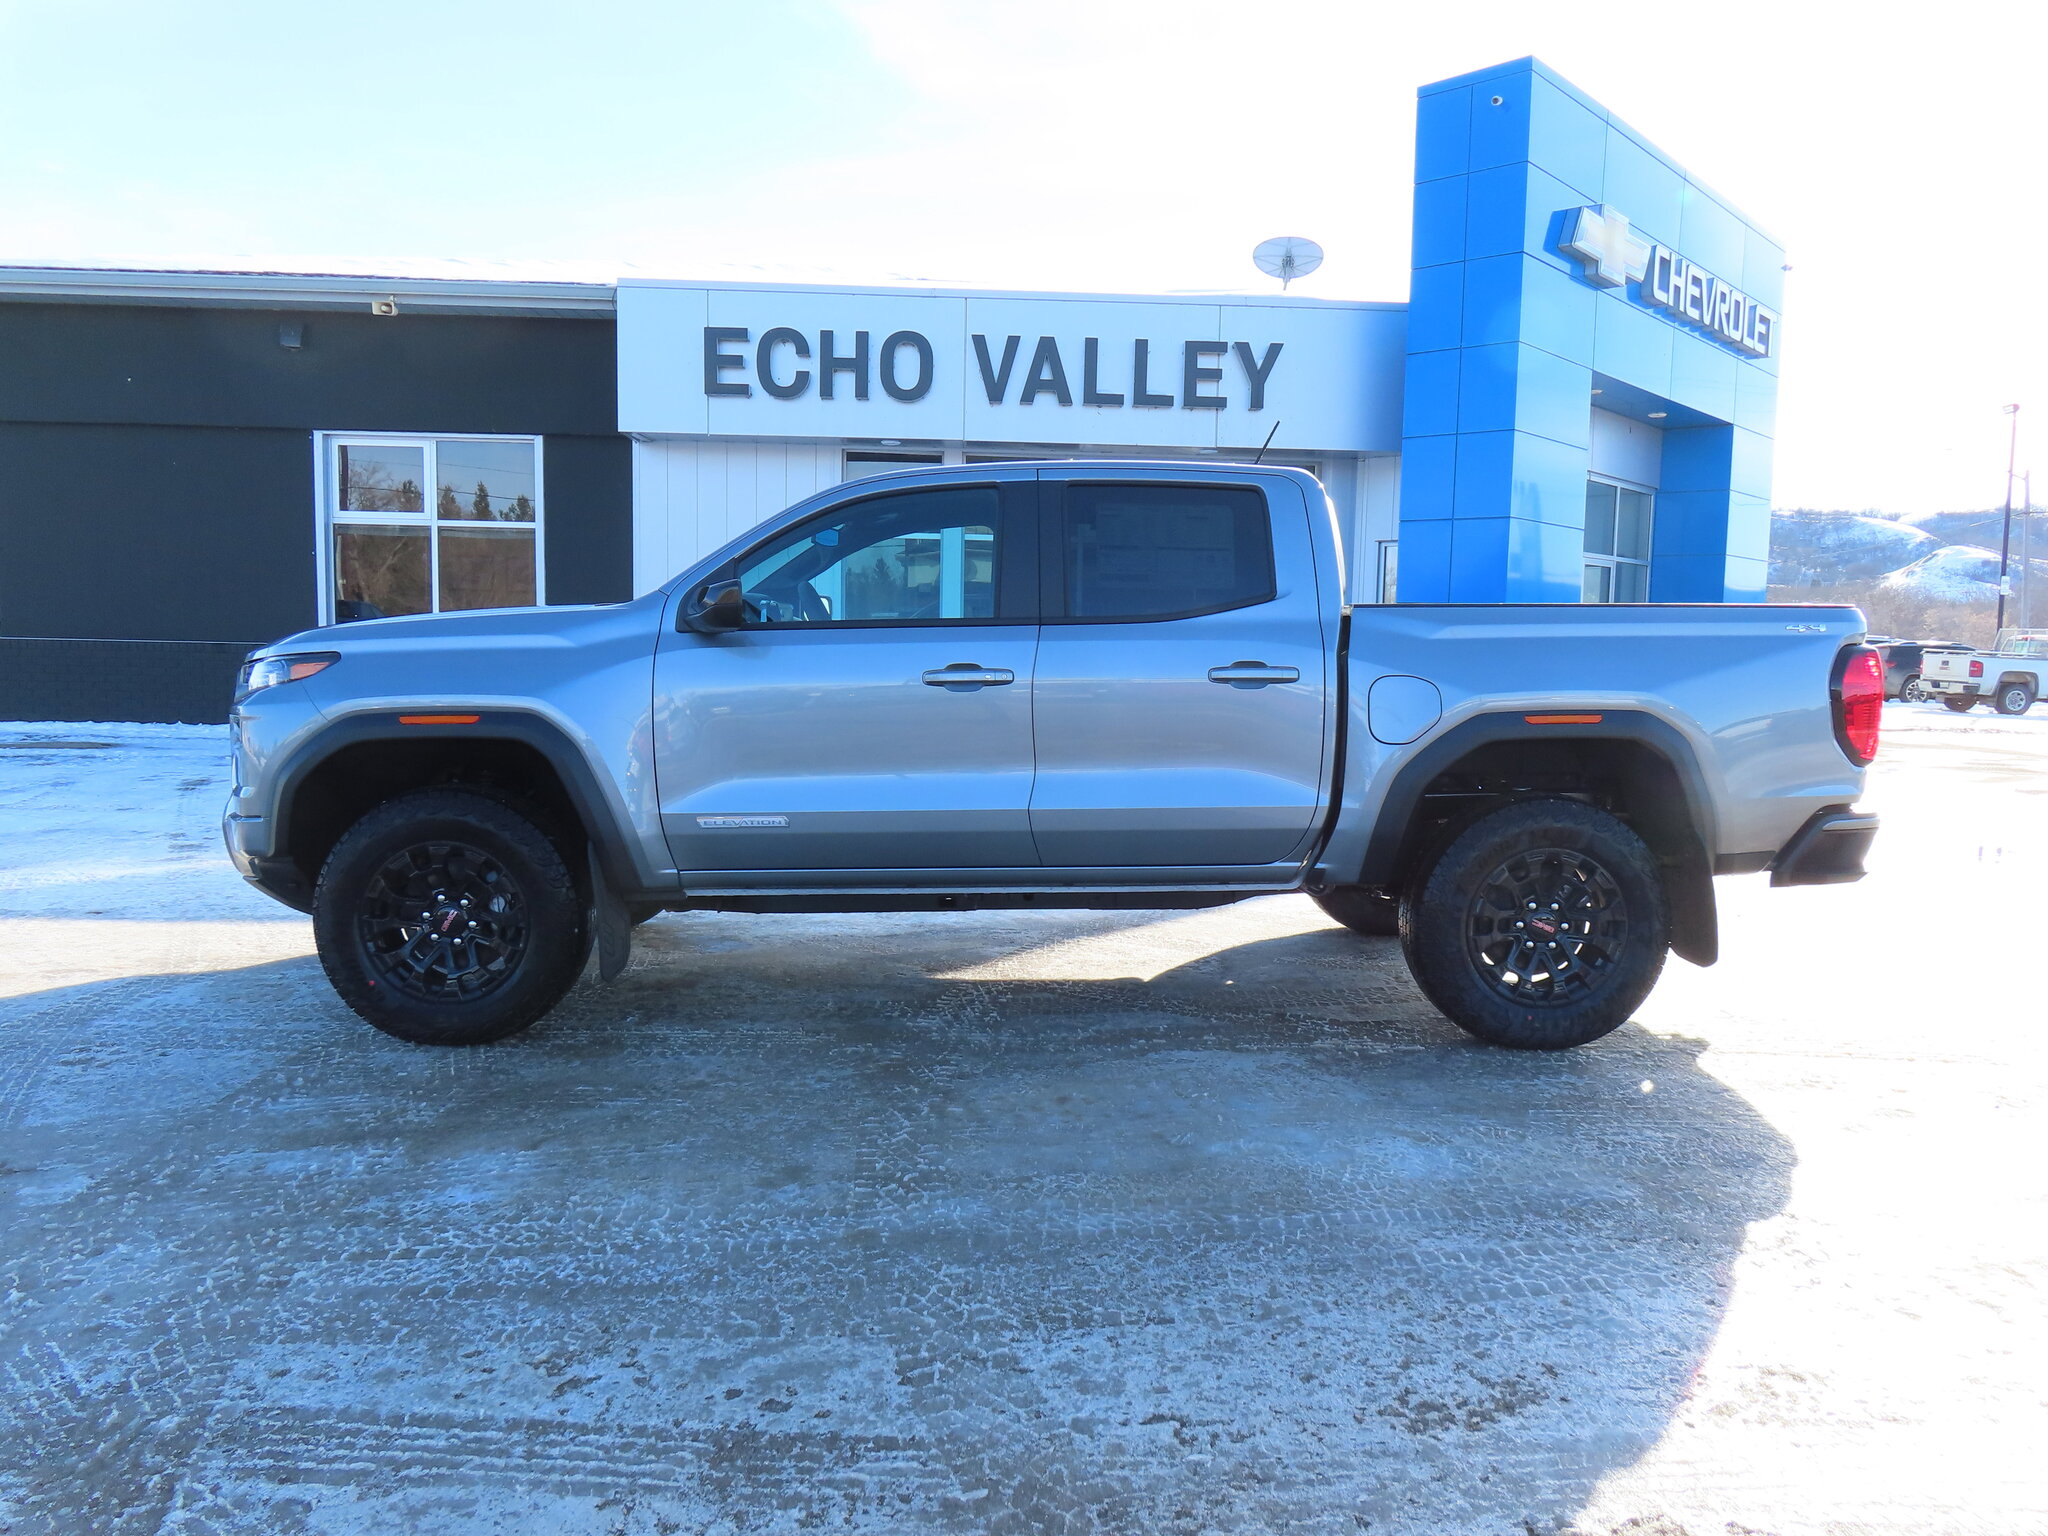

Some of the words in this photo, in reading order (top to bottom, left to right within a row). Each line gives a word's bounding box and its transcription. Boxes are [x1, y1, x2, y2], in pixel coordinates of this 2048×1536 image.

[1652, 244, 1778, 358] CHEVROLET
[703, 326, 934, 403] ECHO
[971, 333, 1284, 412] VALLEY
[702, 818, 783, 827] ELEVATION
